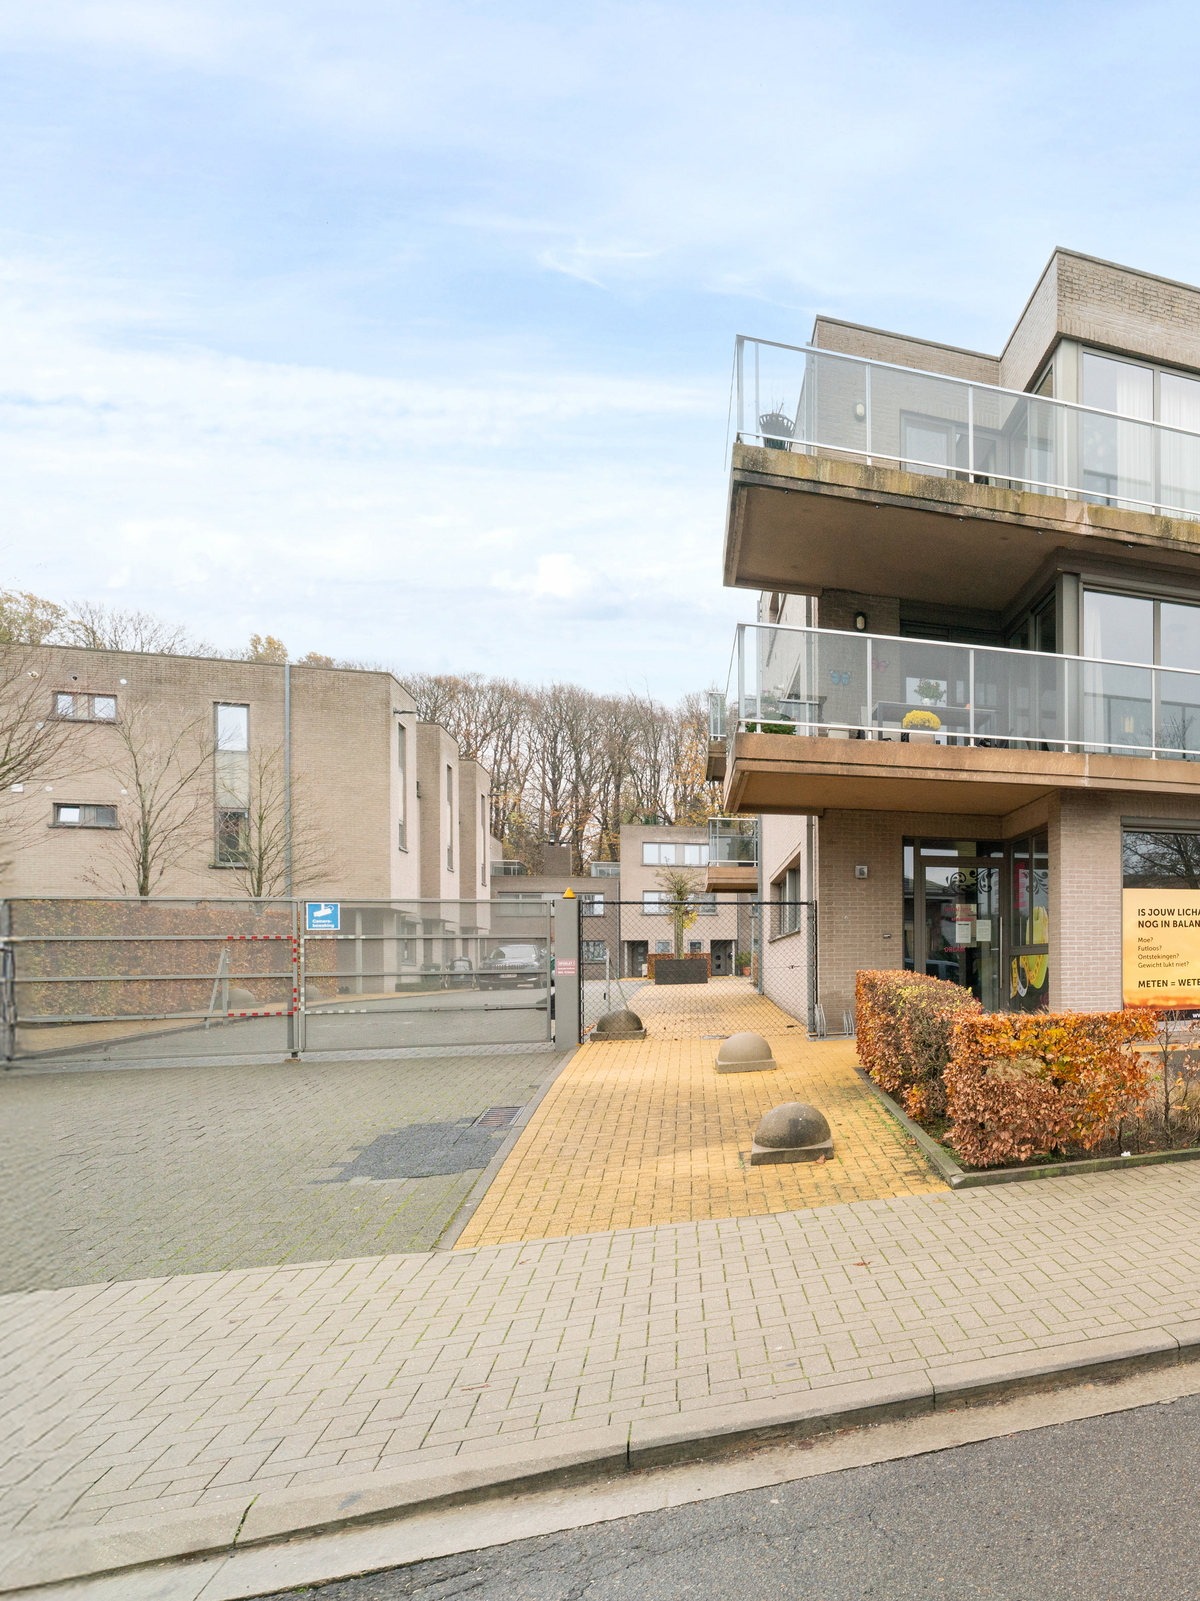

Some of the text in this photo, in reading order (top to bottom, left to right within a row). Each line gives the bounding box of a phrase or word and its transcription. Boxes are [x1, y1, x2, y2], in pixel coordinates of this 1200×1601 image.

[1137, 908, 1146, 916] IS
[1147, 908, 1176, 916] JOUW
[1138, 920, 1159, 928] NOG
[1160, 920, 1170, 928] IN
[1138, 979, 1169, 988] METEN
